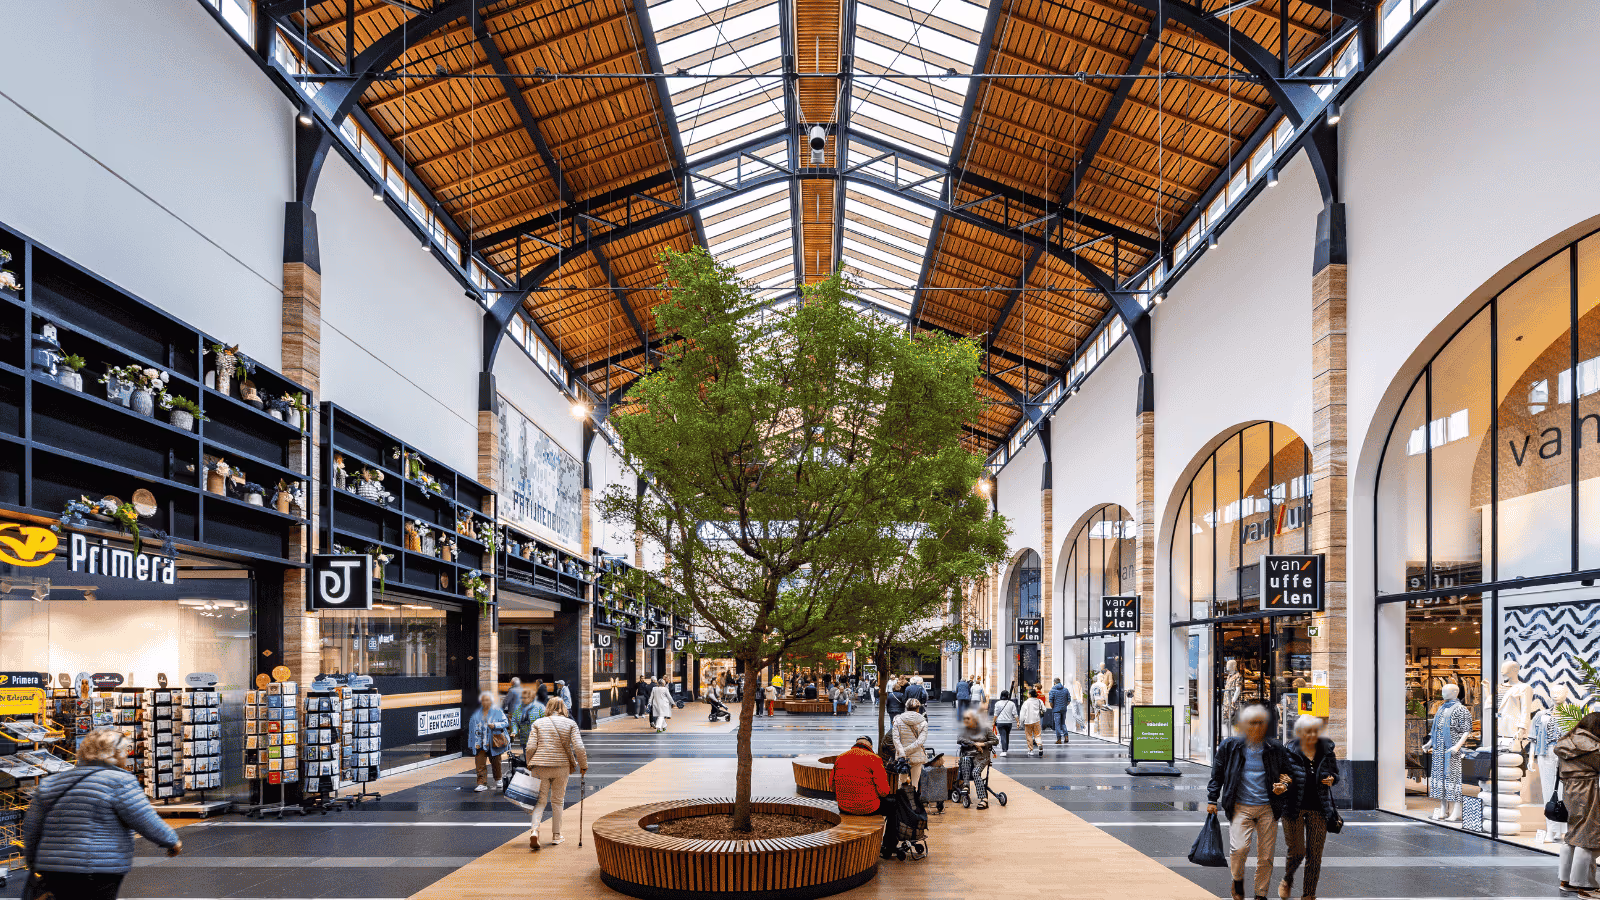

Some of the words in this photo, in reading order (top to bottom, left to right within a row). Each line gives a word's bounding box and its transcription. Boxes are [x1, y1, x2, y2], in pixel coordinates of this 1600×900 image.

[1509, 414, 1600, 467] van
[72, 532, 175, 585] Primera
[1270, 574, 1312, 588] uffe
[1105, 608, 1134, 618] uffe
[12, 675, 39, 685] Primera
[429, 720, 440, 730] EEN
[441, 717, 459, 728] CADEAU
